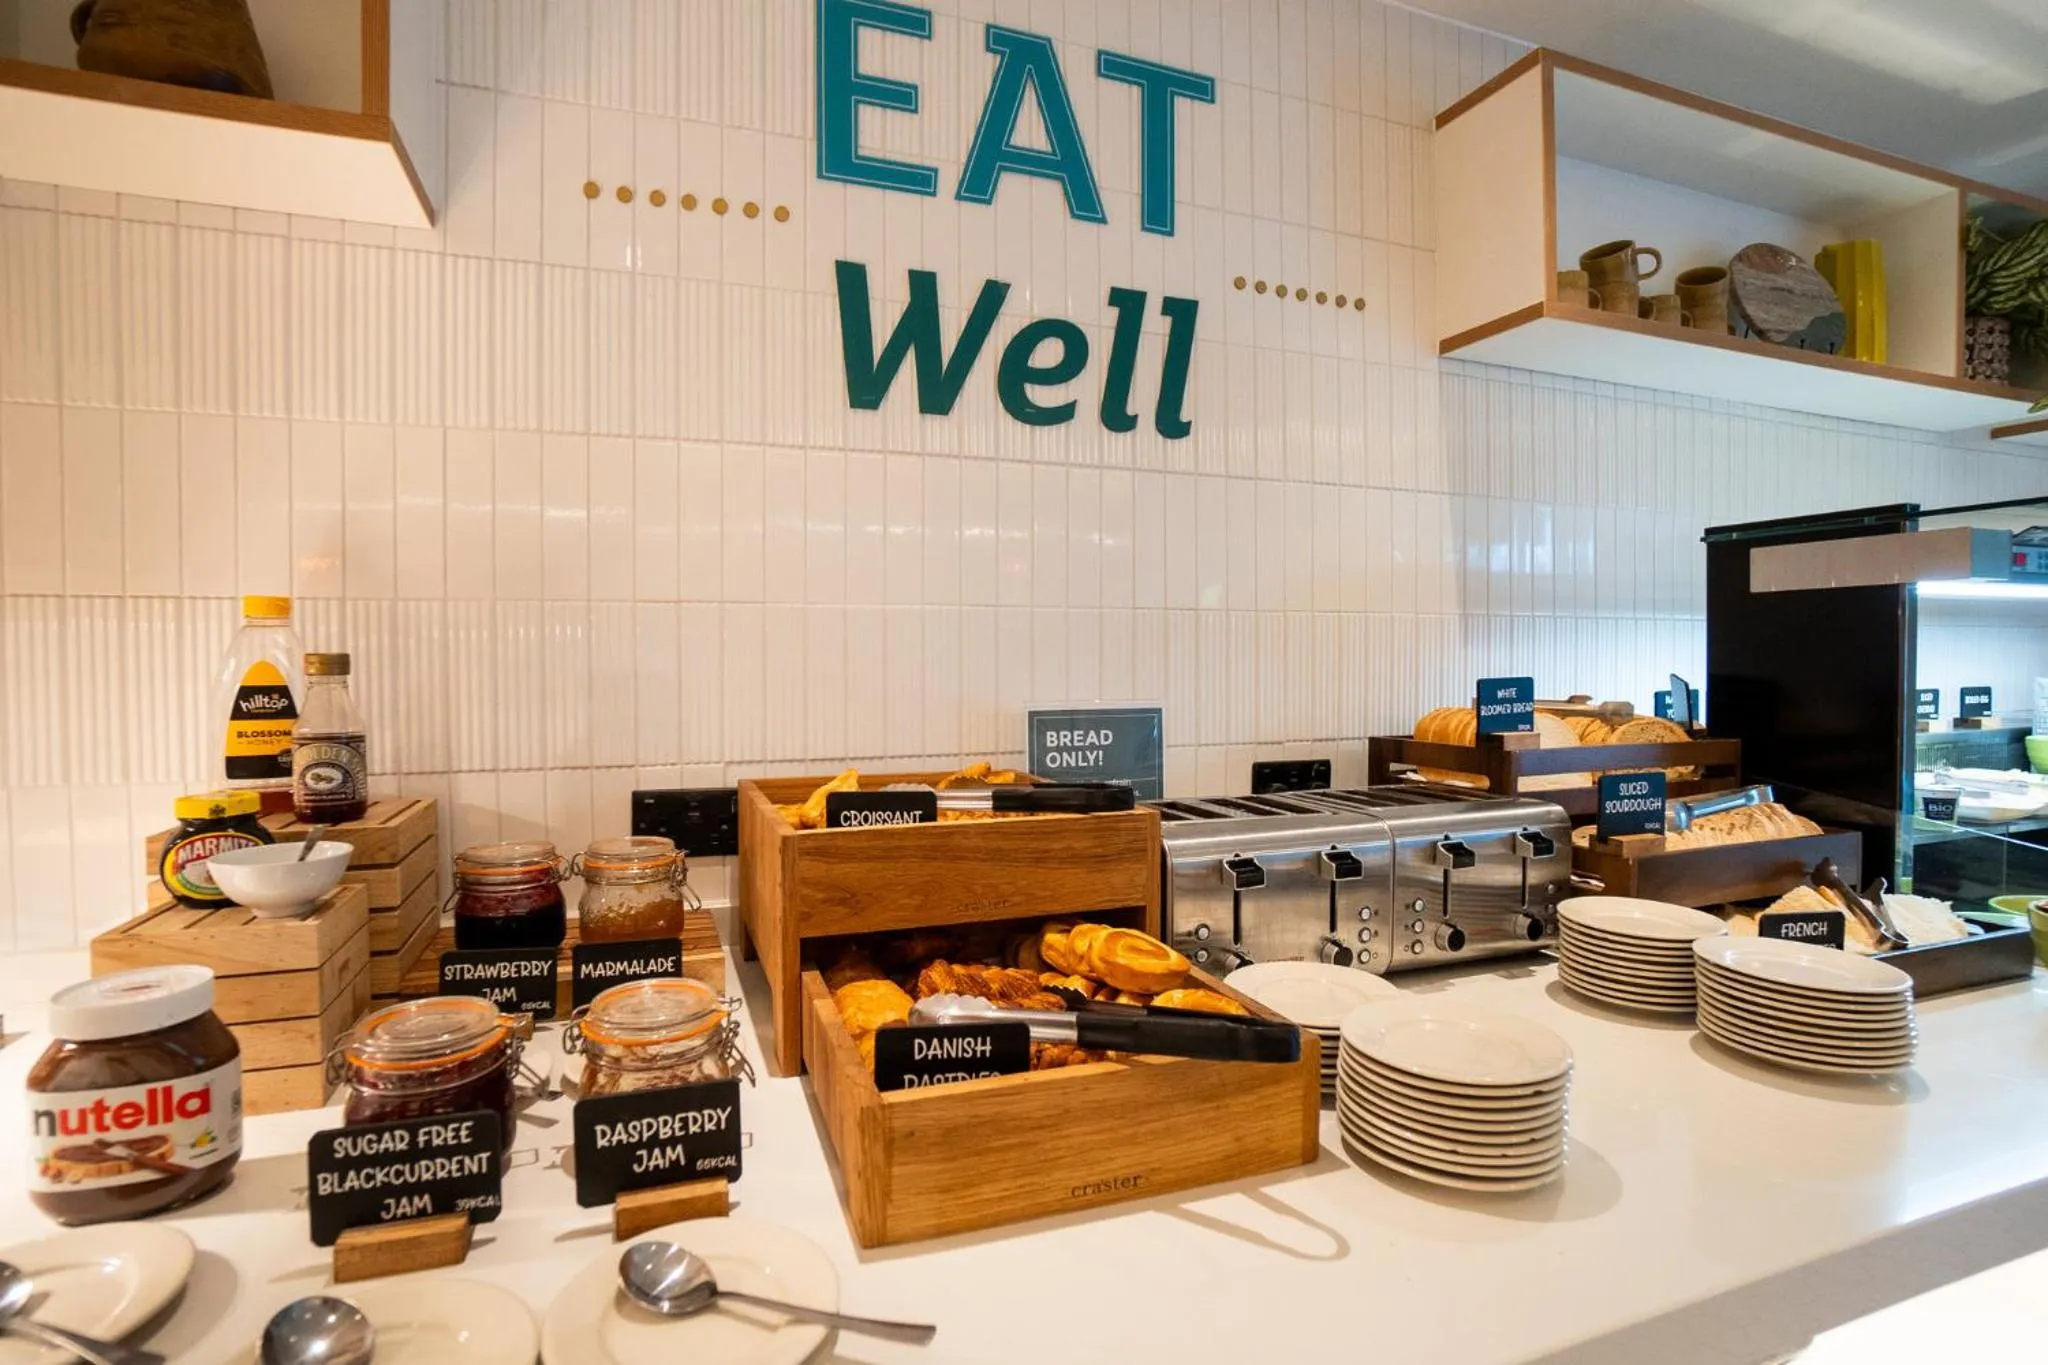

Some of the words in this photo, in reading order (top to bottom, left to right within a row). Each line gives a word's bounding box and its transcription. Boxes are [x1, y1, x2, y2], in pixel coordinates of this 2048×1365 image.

[816, 0, 1215, 237] EAT
[834, 260, 1199, 440] Well
[239, 694, 288, 712] hilltop
[1496, 688, 1518, 699] WHITE
[1480, 704, 1511, 716] BLOOMER
[1512, 702, 1534, 714] BREAD
[237, 729, 292, 739] BLOSSOM
[1046, 730, 1113, 747] BREAD
[1045, 750, 1103, 768] ONLY!
[1619, 781, 1649, 796] SLICED
[1605, 797, 1662, 813] SOURDOUGH
[840, 810, 923, 827] CROISSANT
[178, 837, 257, 863] MARMI
[1781, 921, 1828, 937] FRENCH
[444, 960, 552, 981] STRAWBERRY
[580, 956, 677, 979] MARMALADE
[482, 986, 517, 1003] JAM
[914, 1036, 992, 1060] DANISH
[903, 1071, 1001, 1090] PAST
[33, 1083, 213, 1138] nutella
[594, 1106, 732, 1149] RASPBERRY
[333, 1129, 410, 1159] SUGAR
[416, 1121, 475, 1149] FREE
[633, 1144, 686, 1173] JAM
[317, 1151, 491, 1196] BLACKCURRENT
[1071, 1174, 1145, 1198] craster
[380, 1193, 434, 1220] JAM
